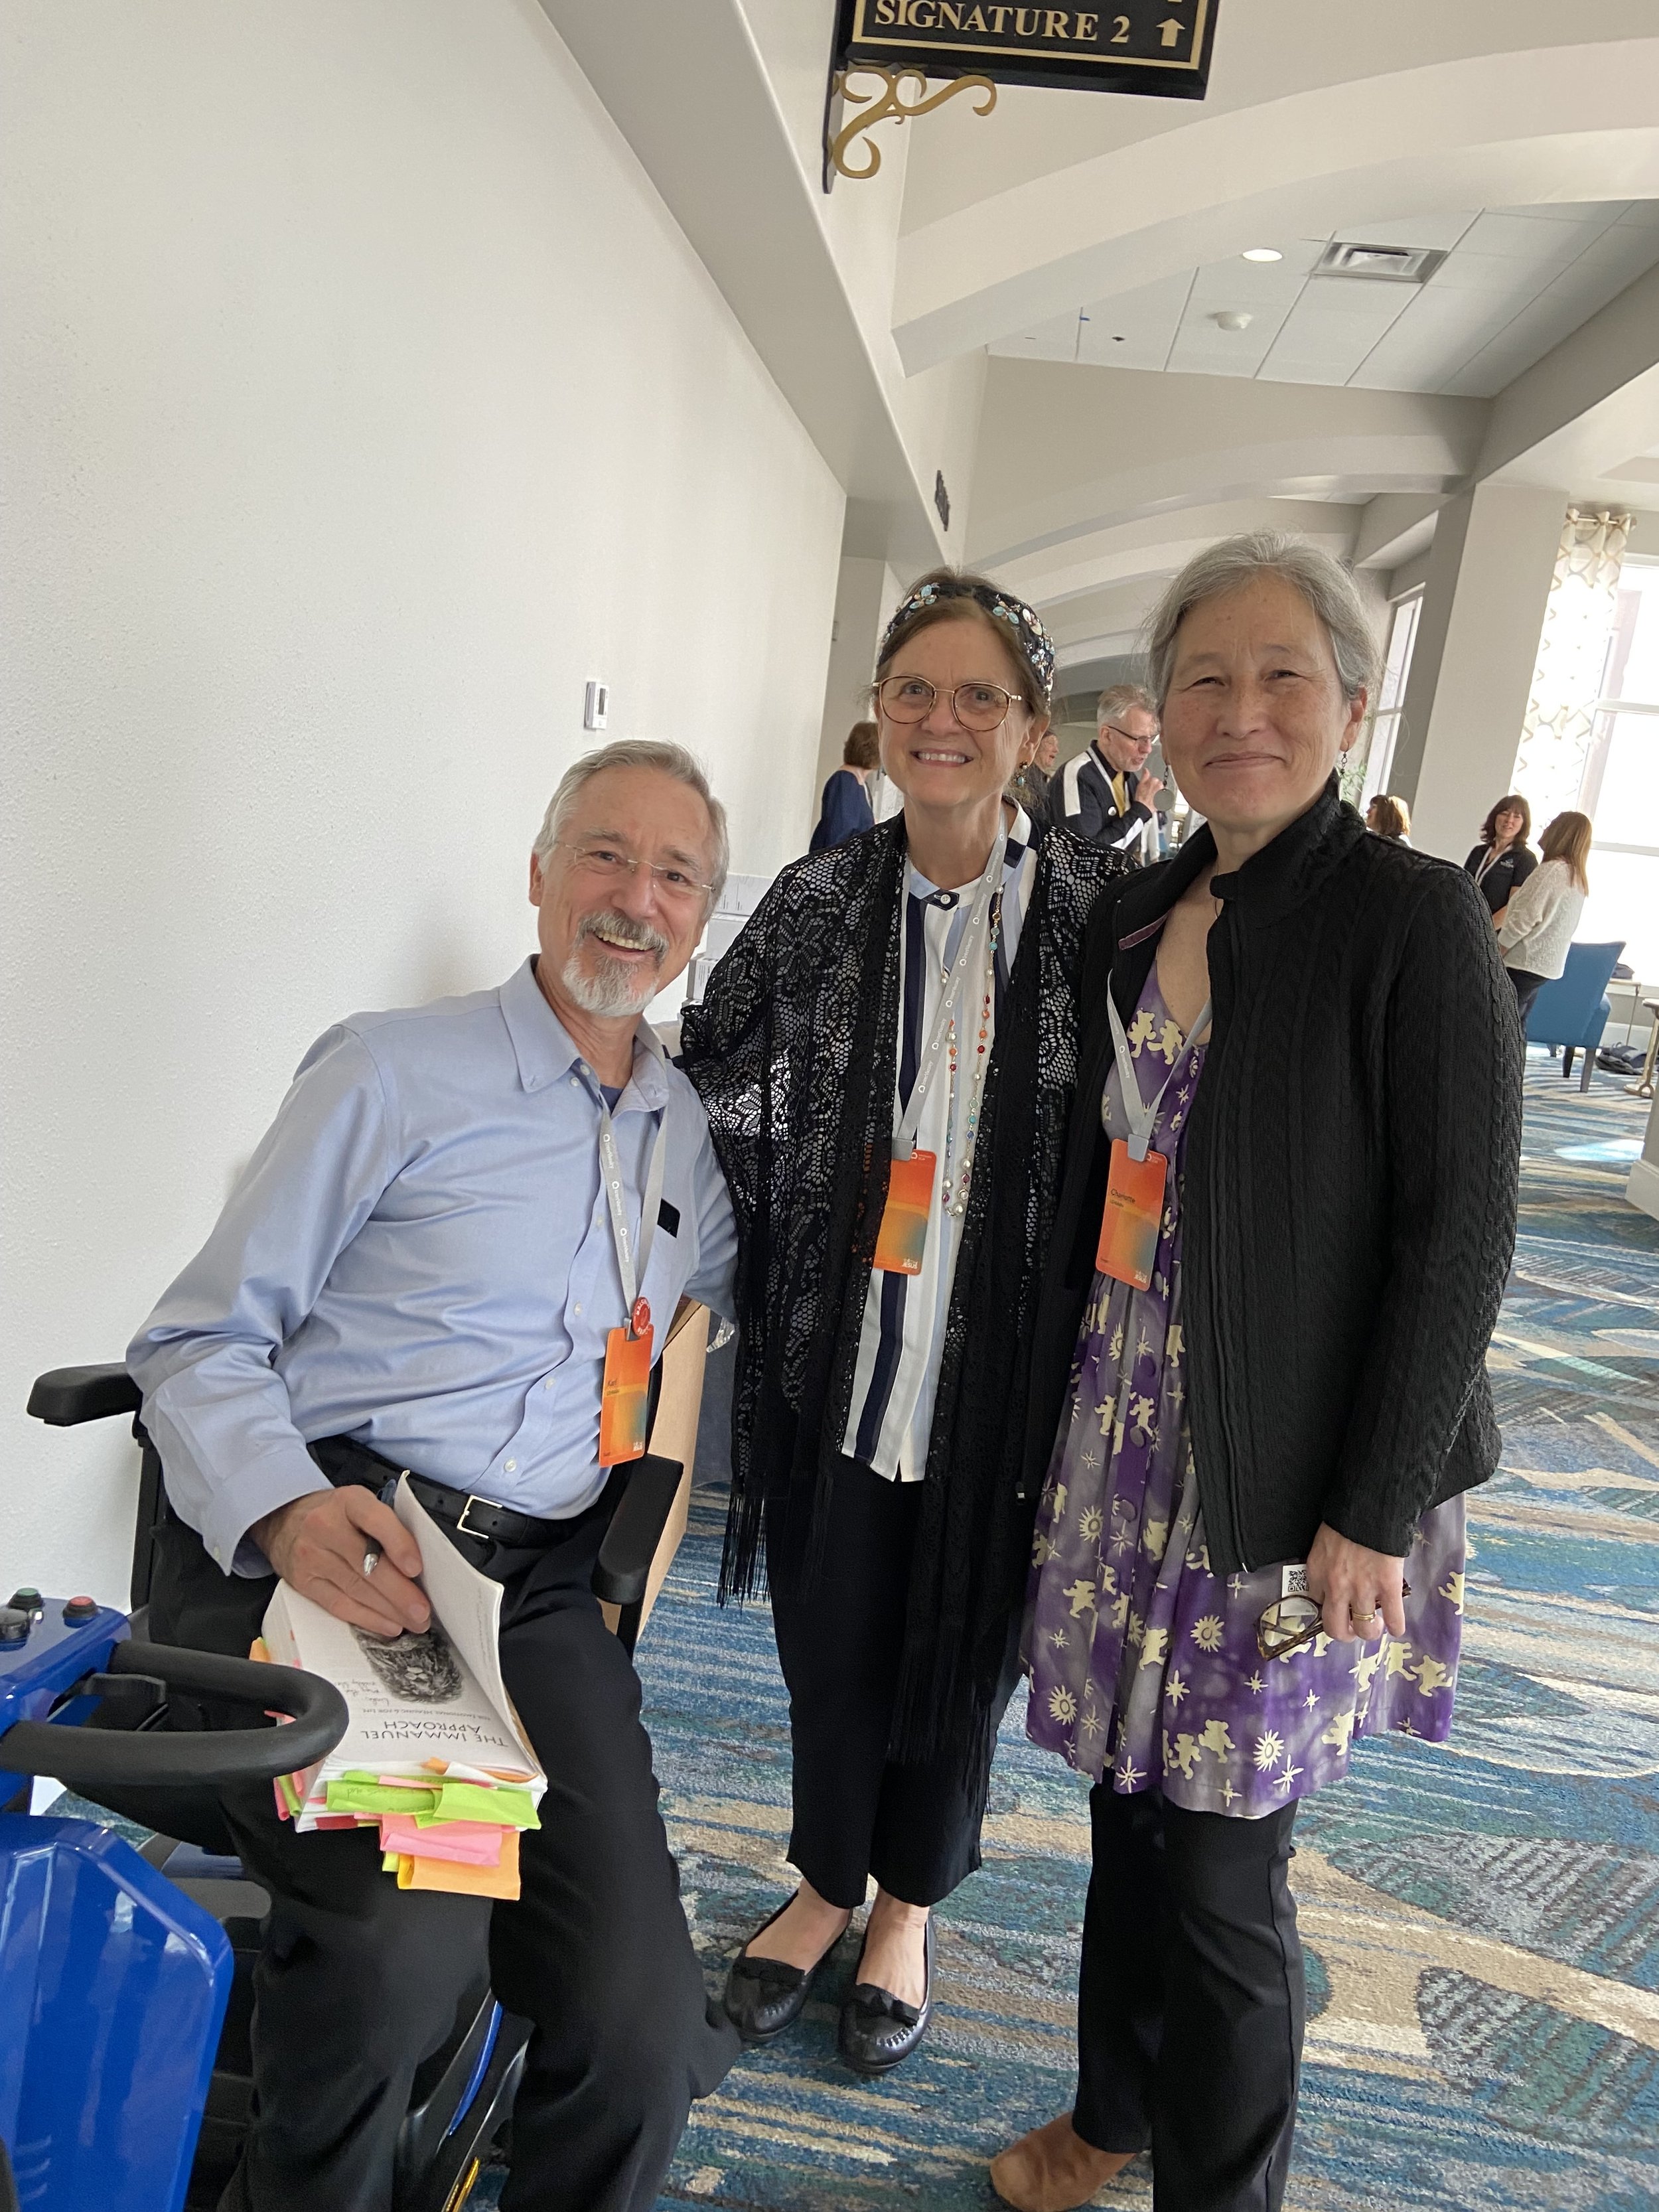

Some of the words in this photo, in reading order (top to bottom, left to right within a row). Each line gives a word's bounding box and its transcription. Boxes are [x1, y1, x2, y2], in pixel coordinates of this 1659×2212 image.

[875, 0, 1100, 41] SIGNATURE
[1110, 15, 1130, 43] 2
[383, 1720, 481, 1734] APPROACH
[360, 1730, 467, 1742] IMMANUEL
[474, 1733, 509, 1747] THE
